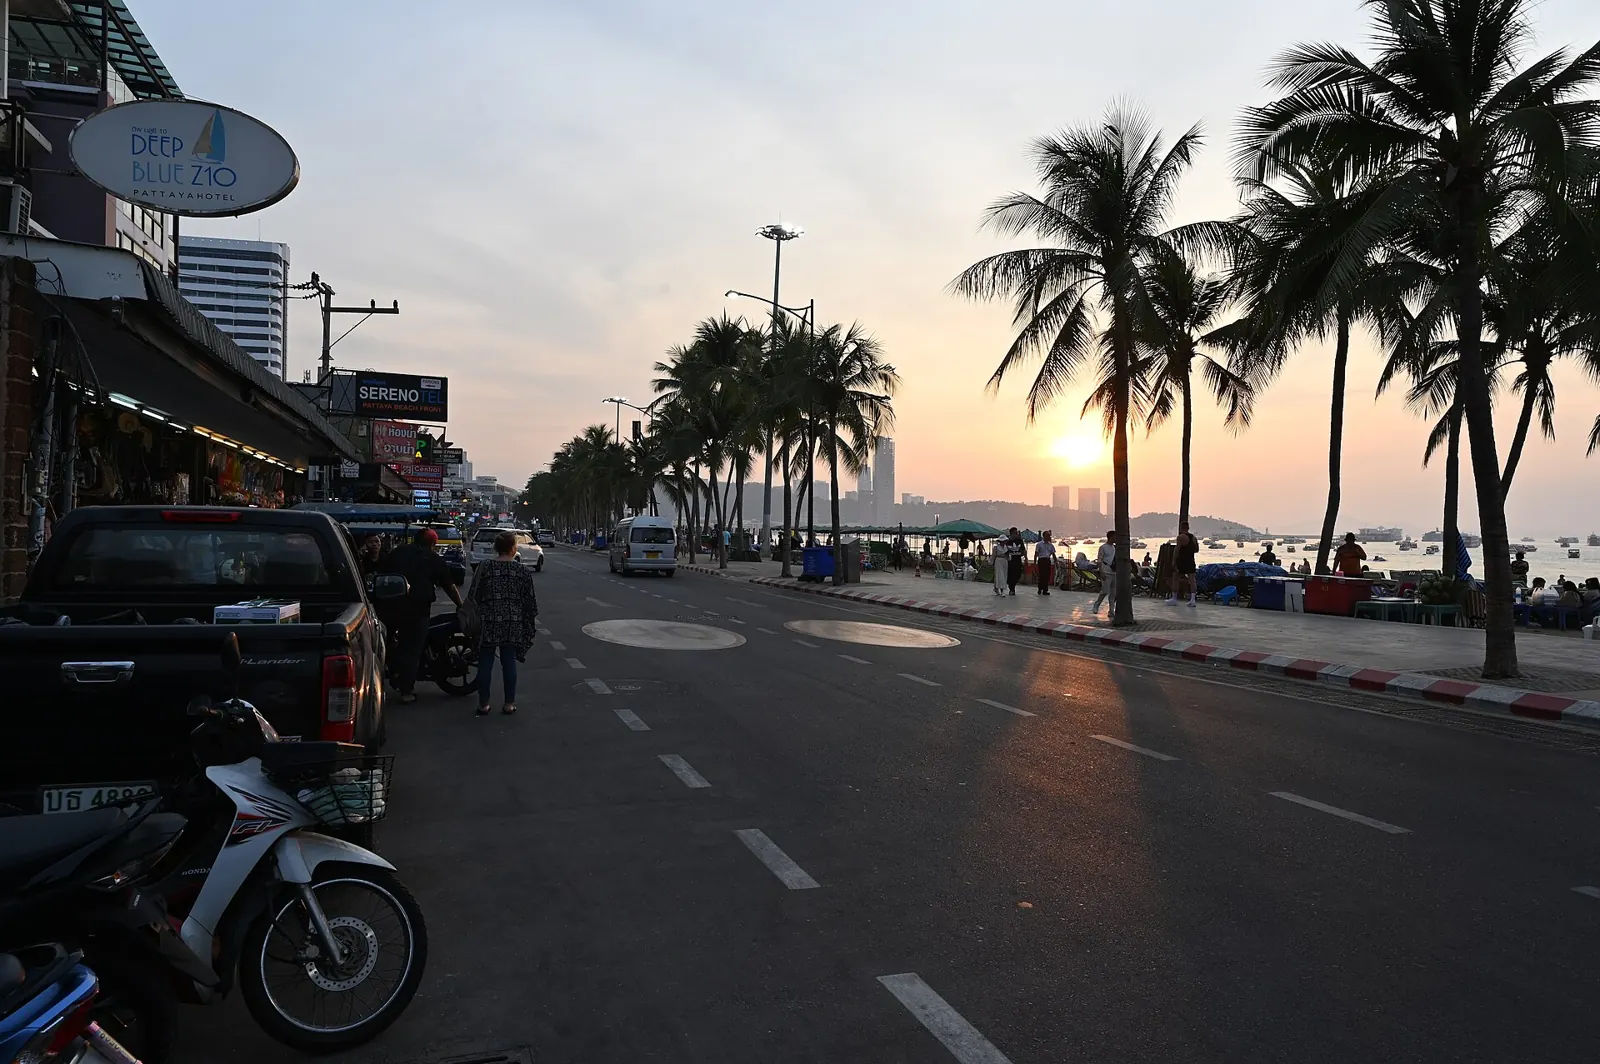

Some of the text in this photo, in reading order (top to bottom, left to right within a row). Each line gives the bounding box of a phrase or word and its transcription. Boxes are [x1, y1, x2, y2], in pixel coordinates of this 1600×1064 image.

[132, 134, 183, 157] DEEP
[132, 161, 237, 187] BLUE Z10
[362, 402, 442, 413] PATTAYA BEACH FRONT
[414, 465, 441, 473] Central
